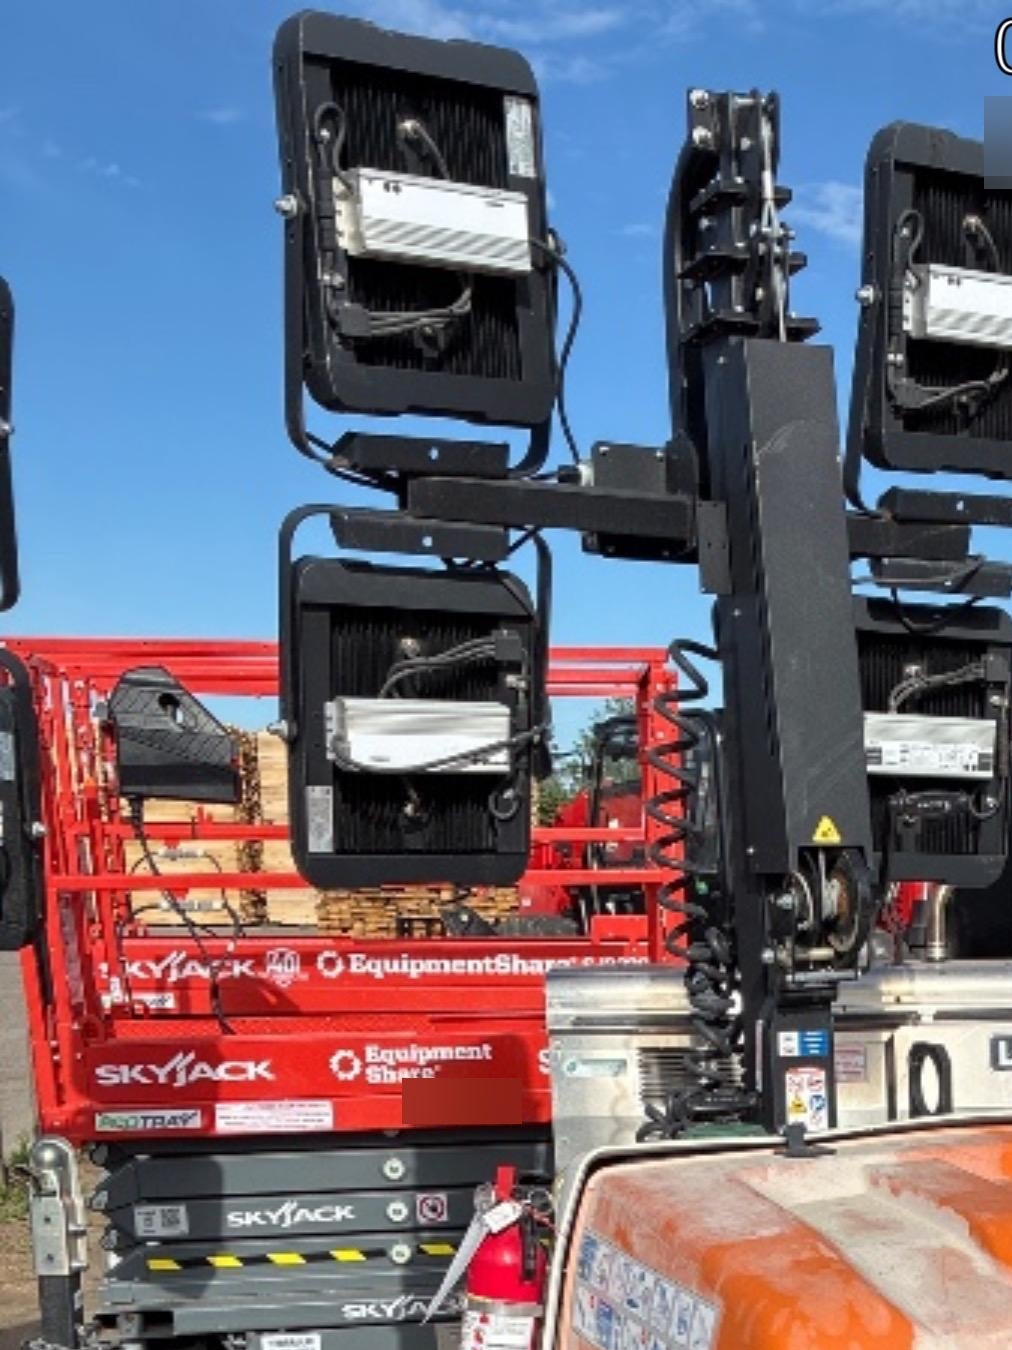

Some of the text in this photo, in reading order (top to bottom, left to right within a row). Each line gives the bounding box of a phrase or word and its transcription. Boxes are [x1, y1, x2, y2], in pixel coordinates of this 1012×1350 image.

[365, 1043, 492, 1064] Equipment
[95, 1051, 275, 1087] SKYJACK
[227, 1201, 355, 1228] SKYJACK
